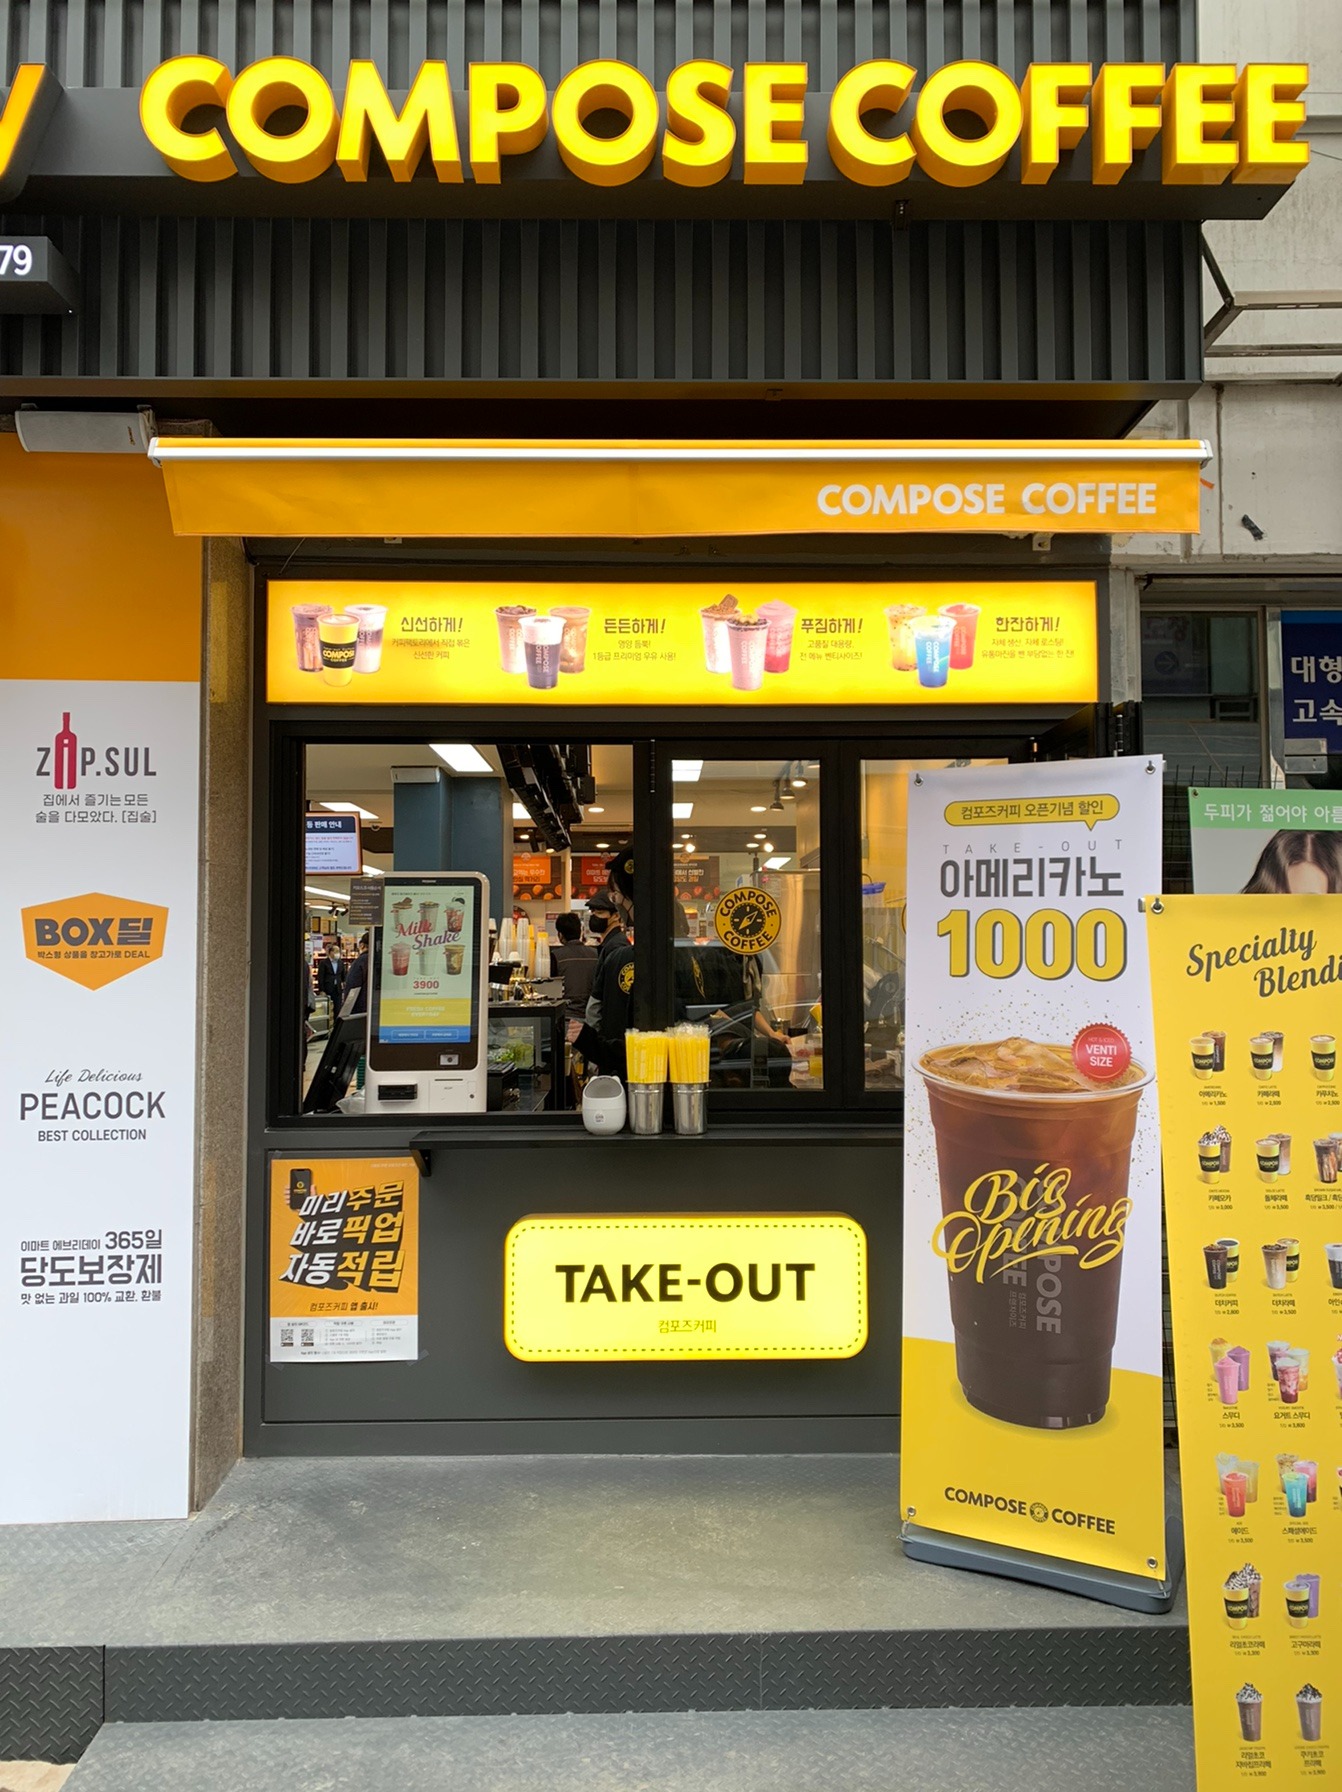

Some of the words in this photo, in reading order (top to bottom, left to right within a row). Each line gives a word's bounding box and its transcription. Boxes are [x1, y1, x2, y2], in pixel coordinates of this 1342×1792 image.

[140, 54, 810, 186] COMPOSE
[826, 58, 1310, 187] COFFEE
[0, 244, 33, 276] 79
[816, 482, 1006, 517] COMPOSE
[1022, 481, 1158, 516] COFFEE
[401, 616, 463, 633] 신선하게!
[604, 618, 666, 634] 든든하게!
[801, 618, 863, 634] 푸짐하게!
[995, 616, 1061, 633] 한잔하게!
[617, 639, 633, 650] 영양
[807, 639, 829, 649] 고품질
[992, 638, 1007, 648] 자체
[1024, 638, 1040, 648] 자체
[413, 650, 435, 660] 신선한
[435, 650, 451, 660] 커피
[593, 651, 612, 661] 1등급
[613, 651, 642, 661] 프리미엄
[643, 651, 658, 661] 우유
[659, 651, 677, 661] 사용!
[800, 652, 807, 662] 전
[808, 652, 823, 661] 메뉴
[824, 651, 863, 661] 벤티사이즈!
[1056, 650, 1064, 659] 한
[43, 794, 80, 807] 집에서
[84, 794, 121, 807] 즐기는
[123, 793, 149, 807] 모든
[35, 810, 60, 824] 술을
[65, 810, 118, 824] 다모았다.
[122, 810, 157, 824] [집술]
[960, 804, 1021, 819] 컴포즈커피
[1024, 801, 1074, 817] 오픈기념
[1078, 800, 1104, 815] 할인
[1204, 804, 1252, 823] 두피가
[1259, 805, 1308, 824] 젊어야
[314, 820, 328, 829] 판매
[328, 820, 343, 829] 안내
[940, 857, 1125, 898] 아메리카노
[720, 891, 777, 917] COMPOSE
[34, 917, 154, 946] BOX딜
[396, 919, 432, 938] Milk
[412, 931, 461, 950] Shake
[724, 931, 773, 950] COFFEE
[937, 908, 1128, 982] 1000
[37, 950, 61, 959] 박스형
[63, 950, 87, 959] 상품을
[124, 950, 150, 959] DEAL
[1186, 927, 1318, 983] Specialty
[413, 980, 440, 990] 3900
[1085, 1043, 1118, 1056] VENTI
[1089, 1056, 1114, 1068] SIZE
[45, 1069, 73, 1087] Life
[77, 1068, 143, 1083] Delicious
[20, 1091, 166, 1121] PEACOCK
[38, 1130, 69, 1142] BEST
[72, 1129, 146, 1142] COLLECTION
[300, 1189, 348, 1216] 미리
[346, 1182, 404, 1211] 주문
[965, 1163, 1072, 1225] Big
[290, 1219, 343, 1246] 바로
[342, 1213, 405, 1244] 픽업
[21, 1240, 50, 1251] 이마트
[52, 1239, 101, 1250] 에브리데이
[105, 1229, 162, 1250] 365일
[931, 1197, 1134, 1285] Opening
[20, 1254, 162, 1287] 당도보장제
[280, 1251, 339, 1284] 자동
[336, 1250, 405, 1287] 적립
[555, 1262, 816, 1303] TAKE-OUT
[21, 1293, 31, 1305] 맛
[35, 1292, 55, 1304] 없는
[59, 1292, 80, 1304] 과일
[83, 1292, 112, 1303] 100%
[141, 1290, 162, 1302] 환불
[309, 1302, 348, 1312] 컴포즈커피
[350, 1302, 358, 1311] 앱
[359, 1301, 378, 1311] 출시!
[658, 1320, 717, 1333] 컴포즈커피
[1222, 1412, 1240, 1420] 스무디
[1273, 1412, 1292, 1420] 요거트
[1293, 1412, 1310, 1420] 스무디
[944, 1486, 1027, 1516] COMPOSE
[1051, 1508, 1116, 1535] COFFEE
[1231, 1527, 1250, 1535] 에이드
